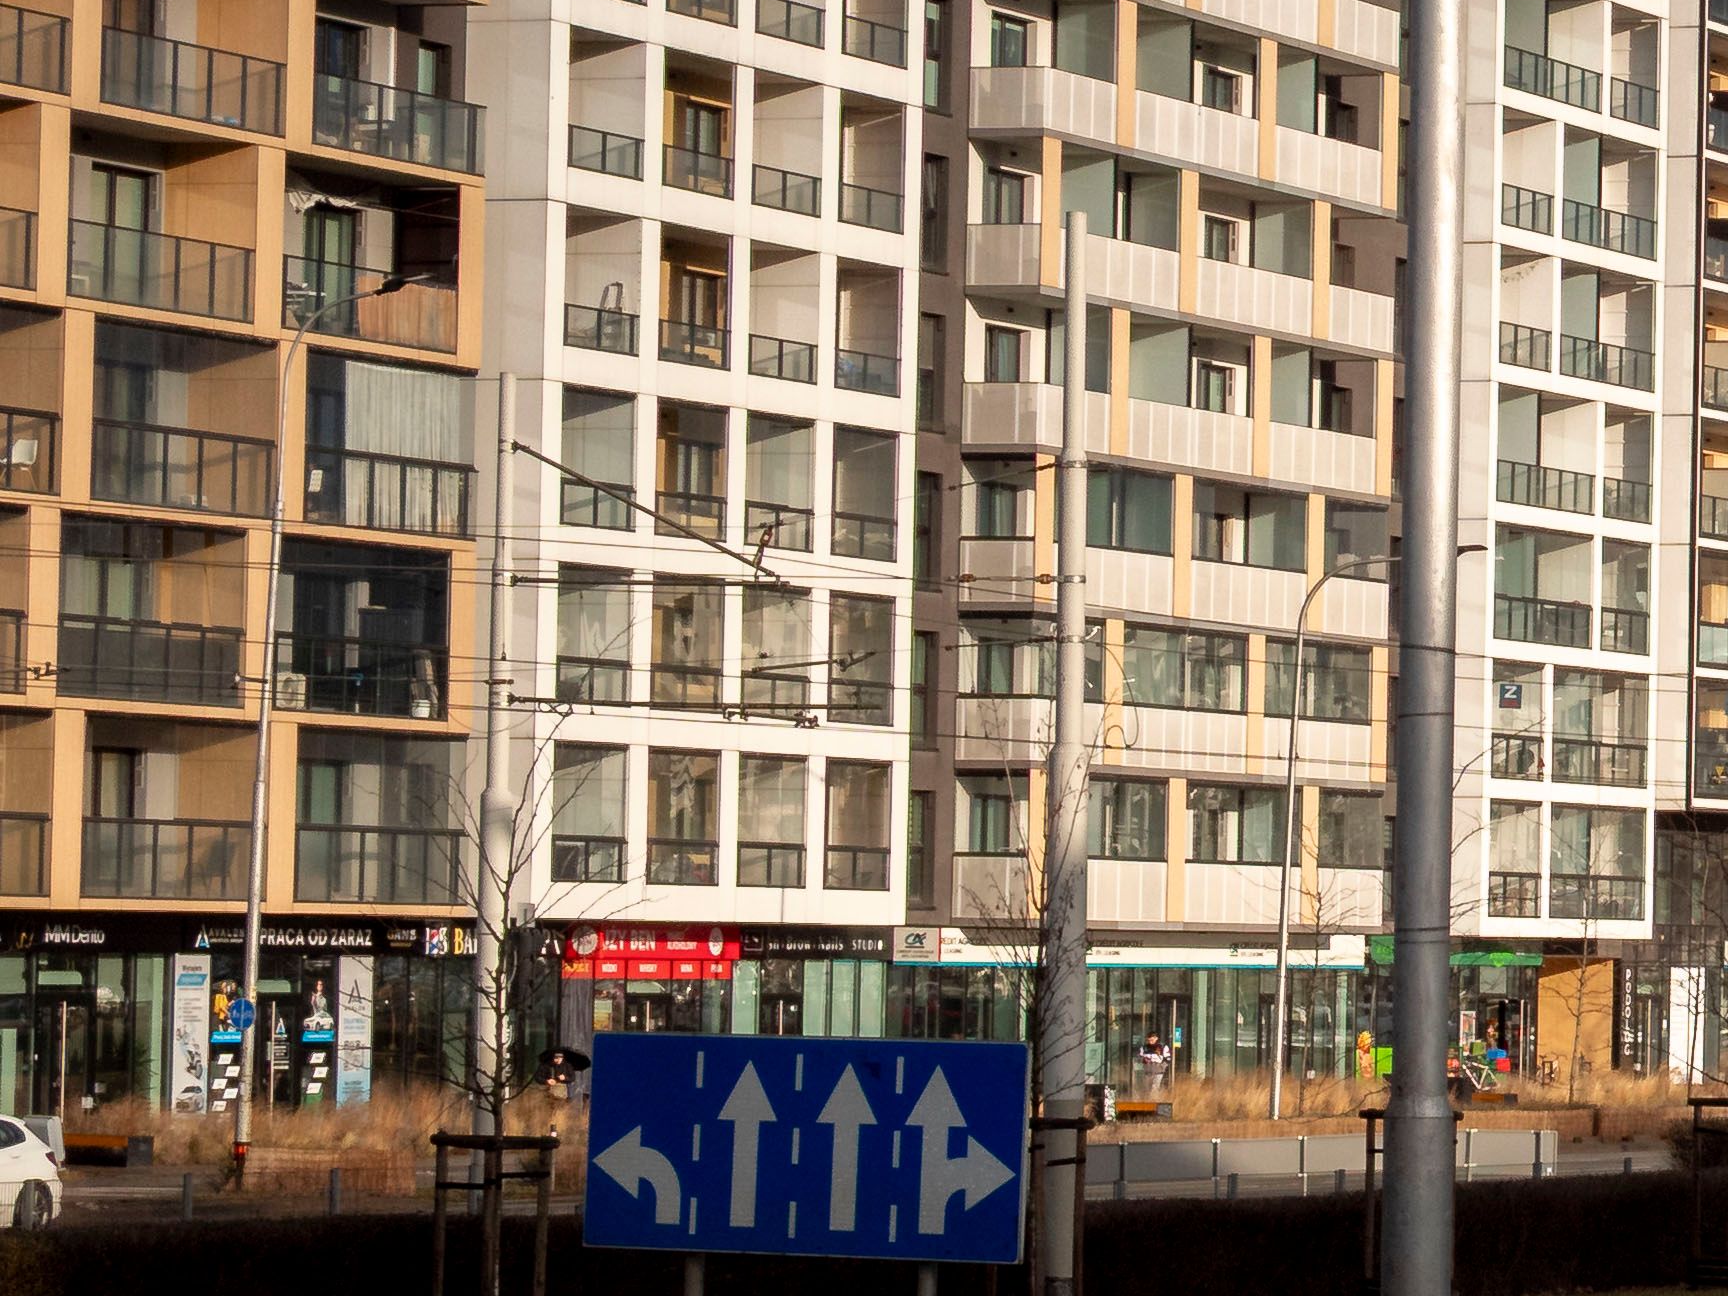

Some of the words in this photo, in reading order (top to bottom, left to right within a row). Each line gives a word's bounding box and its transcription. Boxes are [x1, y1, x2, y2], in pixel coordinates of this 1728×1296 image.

[260, 928, 305, 946] PRACA
[308, 928, 328, 946] OD
[330, 928, 372, 947] ZARAZ
[852, 938, 884, 951] STUDIO
